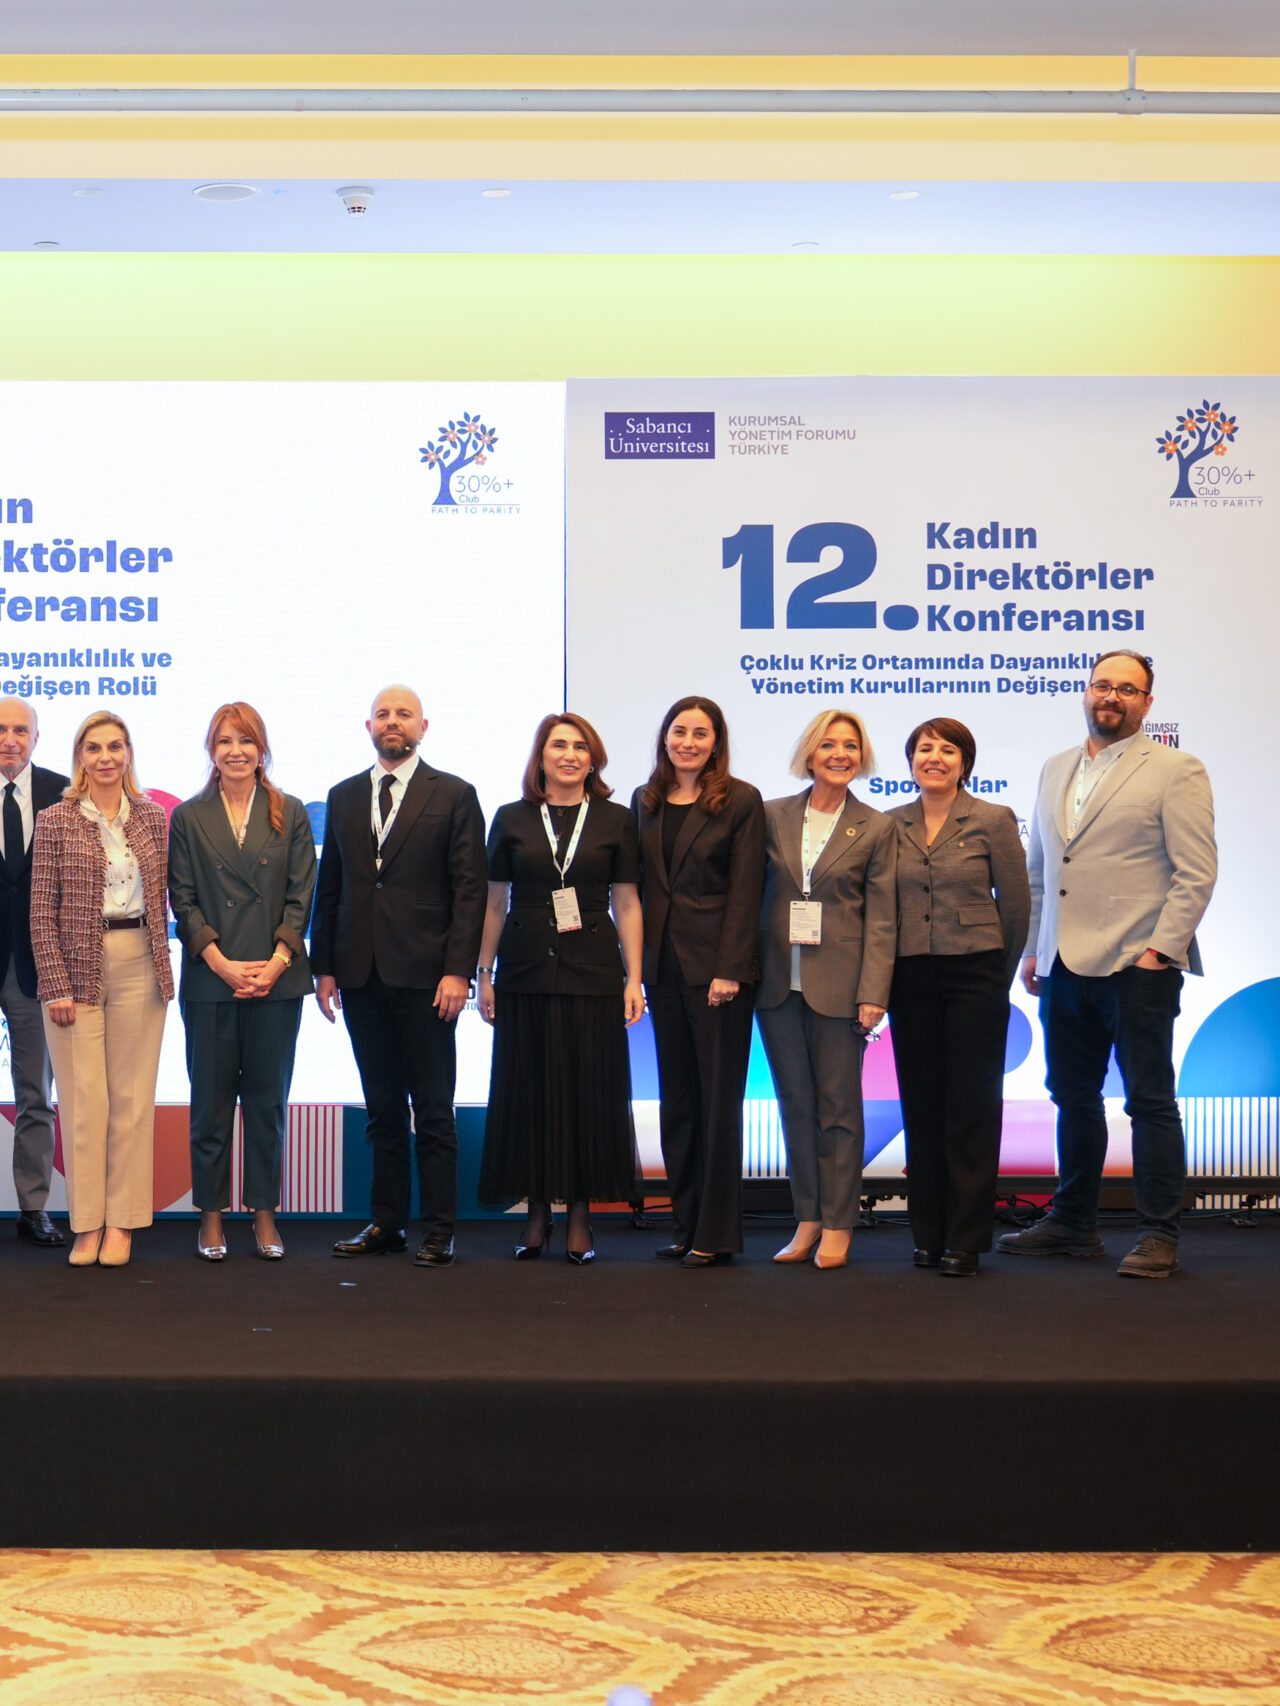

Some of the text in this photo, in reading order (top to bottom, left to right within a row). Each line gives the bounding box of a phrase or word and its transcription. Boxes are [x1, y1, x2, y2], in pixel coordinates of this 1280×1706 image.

[626, 418, 692, 433] Sabancı
[728, 416, 805, 426] KURUMSAL
[728, 428, 856, 440] YÖNETİM FORUMU
[728, 442, 789, 455] TÜRKİYE
[455, 475, 514, 493] 30%+
[1194, 466, 1256, 485] 30%+
[459, 495, 480, 503] Club
[1198, 487, 1220, 496] Club
[927, 522, 1037, 549] Kadın
[722, 522, 919, 631] 12.
[927, 561, 1154, 590] Direktörler
[927, 603, 1144, 631] Konferansı
[142, 653, 172, 667] ve
[740, 654, 804, 674] Çoklu
[810, 653, 857, 670] Kriz
[862, 653, 984, 670] Ortamında
[98, 676, 156, 695] Rolü
[751, 675, 1086, 696] Yönetim Kurullarının Değişen
